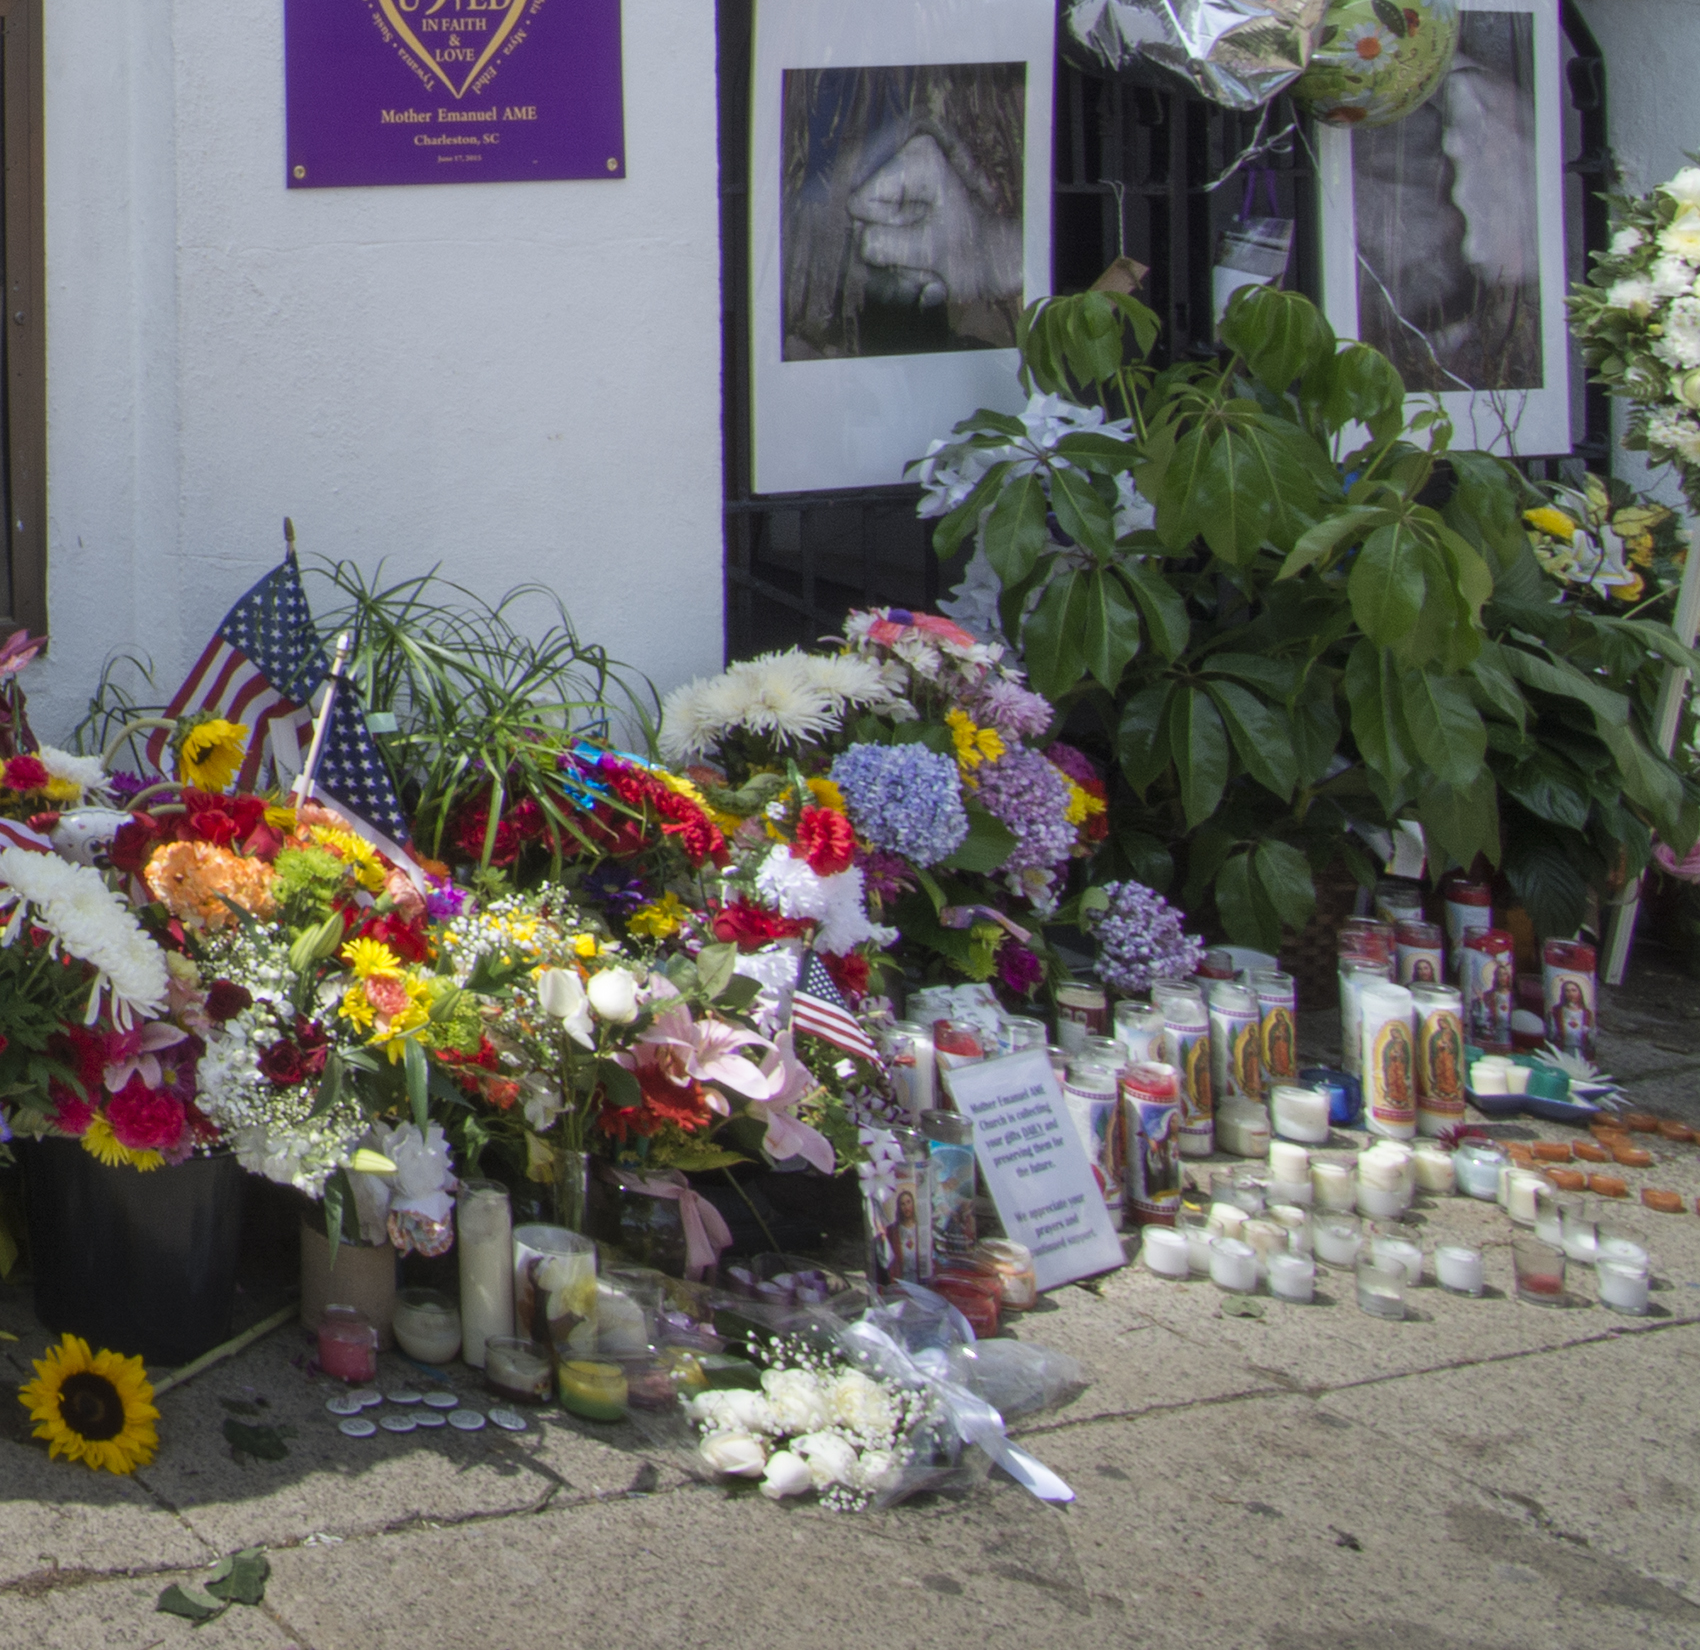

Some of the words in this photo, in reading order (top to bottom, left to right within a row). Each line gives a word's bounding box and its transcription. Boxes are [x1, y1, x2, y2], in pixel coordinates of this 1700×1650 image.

[371, 11, 394, 44] Susie
[421, 18, 438, 32] IN
[441, 18, 488, 32] FAITH
[448, 34, 461, 47] &
[502, 27, 528, 57] Myra
[435, 48, 476, 62] LOVE
[397, 47, 435, 93] Tywanza
[471, 65, 498, 95] Ethel
[381, 109, 432, 124] Mother
[437, 106, 498, 123] Emanuel
[502, 106, 538, 121] AME
[414, 133, 481, 147] Charleston,
[482, 133, 500, 146] SC
[978, 1116, 1007, 1132] Church
